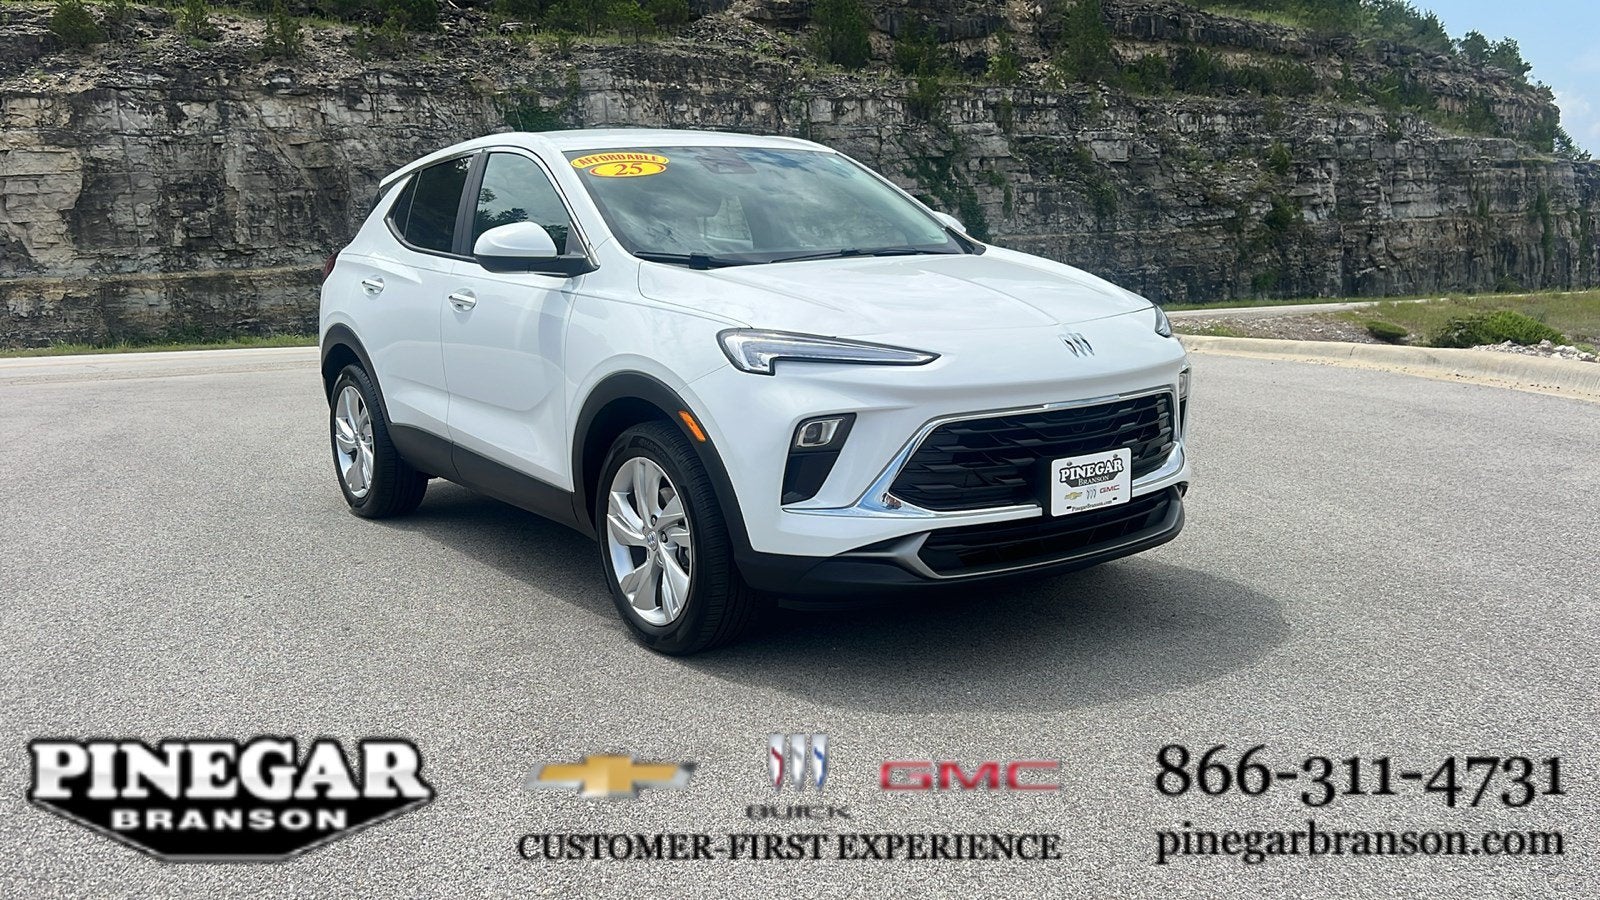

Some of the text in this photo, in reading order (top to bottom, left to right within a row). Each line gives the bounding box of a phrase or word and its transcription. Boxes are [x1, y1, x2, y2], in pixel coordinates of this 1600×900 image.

[577, 152, 659, 166] AFFORDABLE
[614, 161, 643, 176] 25
[1060, 459, 1124, 482] PINEGAR
[1099, 485, 1120, 494] GMC
